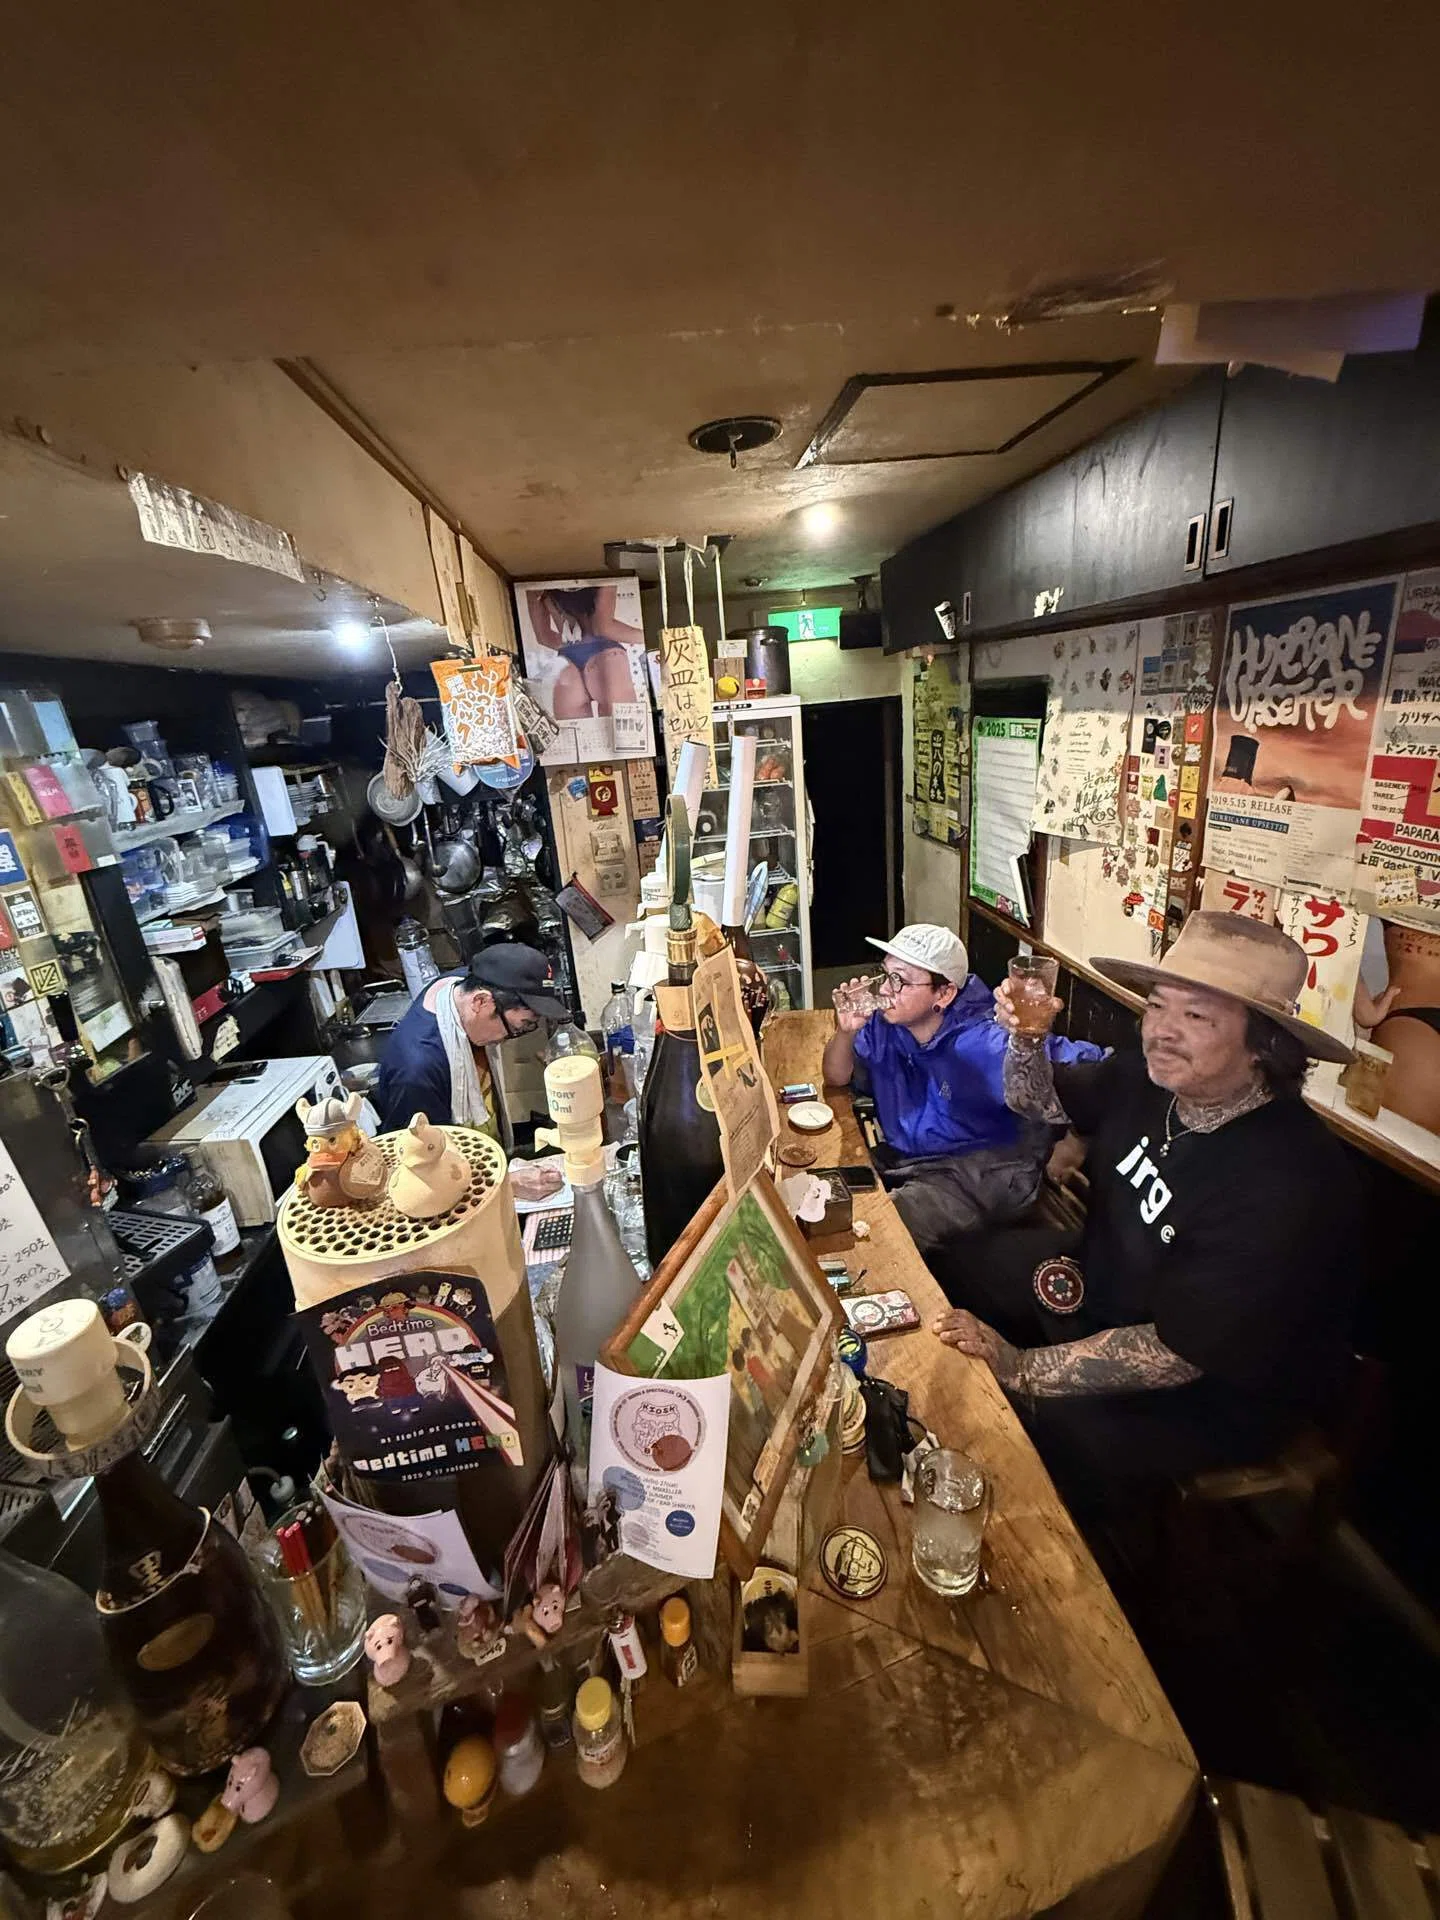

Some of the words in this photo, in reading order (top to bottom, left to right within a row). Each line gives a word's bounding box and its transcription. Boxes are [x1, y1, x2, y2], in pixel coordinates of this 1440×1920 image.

[986, 722, 1006, 737] 2025
[1385, 743, 1440, 758] トンマルテ
[1250, 800, 1294, 816] RELEASE
[1407, 846, 1440, 862] Loom
[1303, 895, 1346, 990] サワー
[367, 1318, 434, 1337] Bedtime
[643, 1404, 676, 1415] KIOSK
